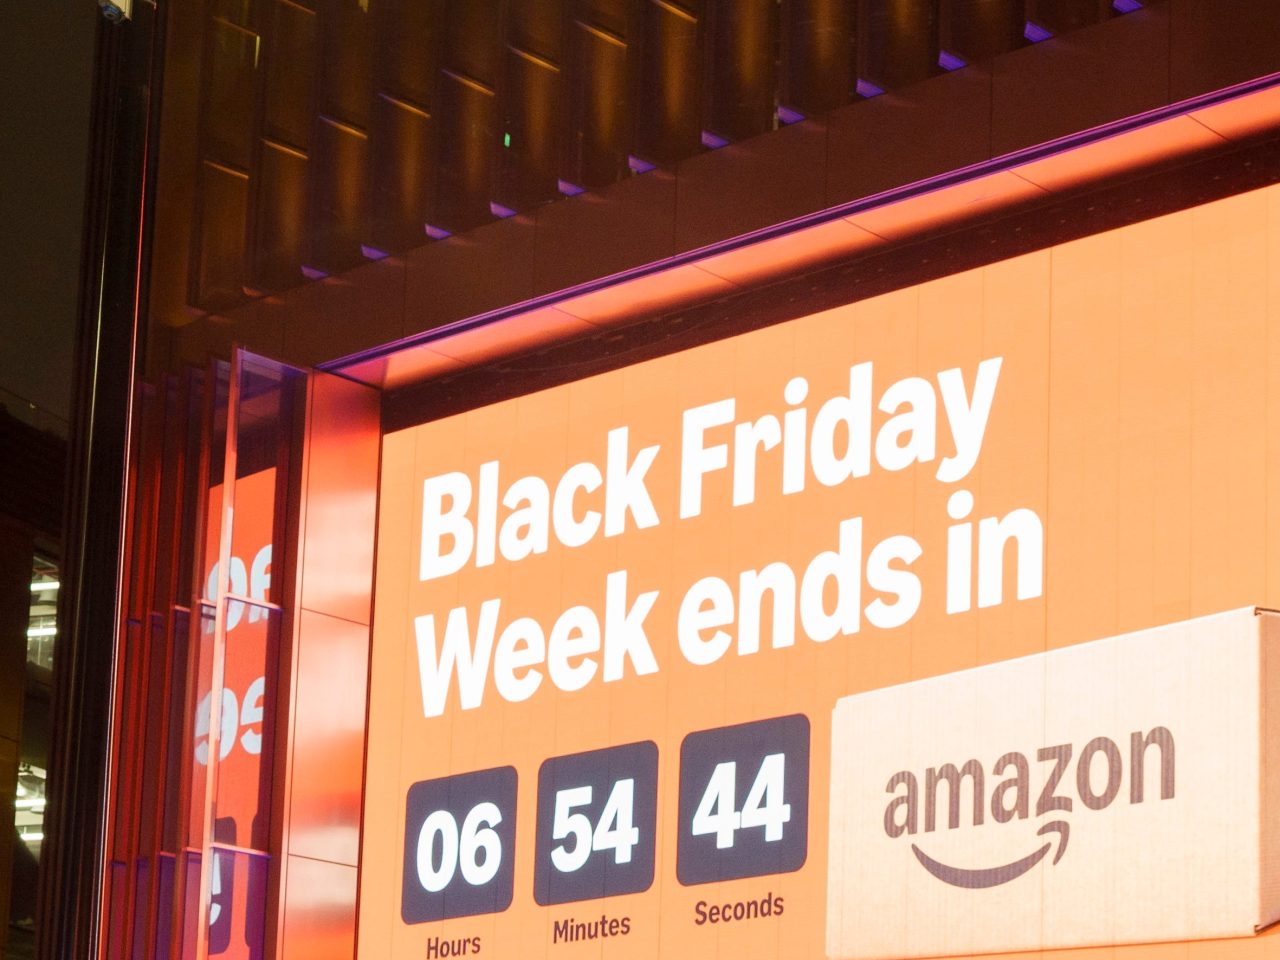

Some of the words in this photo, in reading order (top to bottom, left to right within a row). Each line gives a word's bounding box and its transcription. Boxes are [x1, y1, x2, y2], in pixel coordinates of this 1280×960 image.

[418, 426, 661, 582] Black
[679, 356, 1004, 520] Friday
[414, 569, 660, 719] Week
[677, 515, 923, 666] ends
[945, 489, 1045, 616] in
[550, 778, 640, 874] 54
[691, 752, 791, 850] 44
[883, 725, 1176, 839] amazon
[416, 801, 504, 893] 06
[425, 934, 482, 960] Hours
[552, 914, 631, 945] Minutes
[694, 892, 785, 926] Seconds
